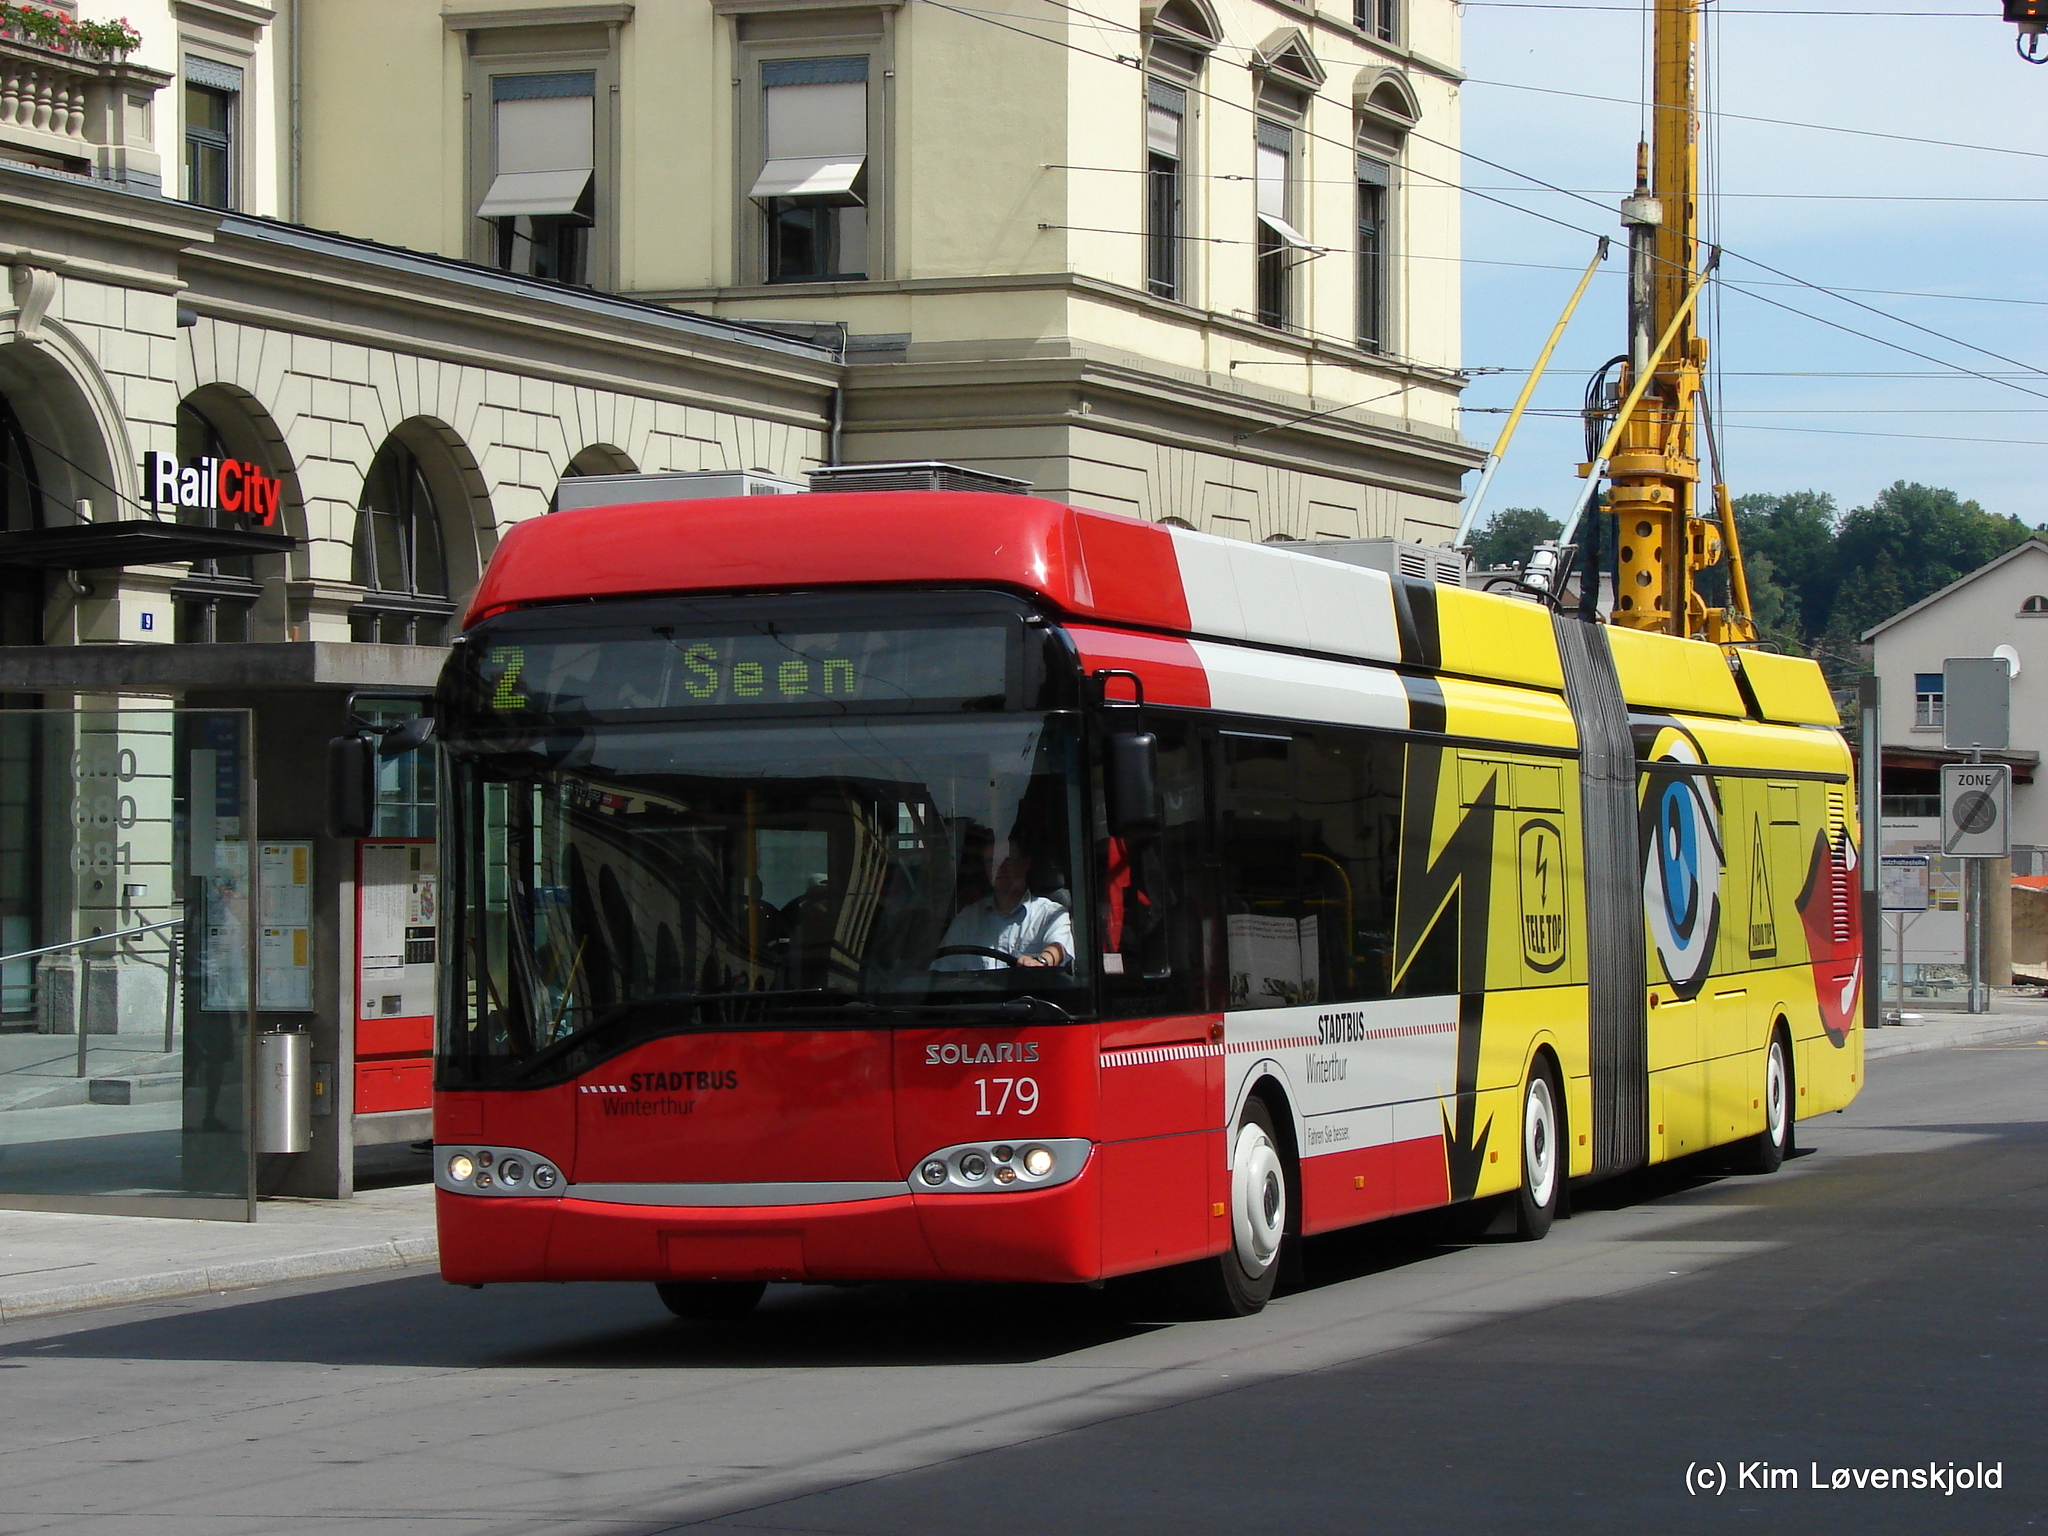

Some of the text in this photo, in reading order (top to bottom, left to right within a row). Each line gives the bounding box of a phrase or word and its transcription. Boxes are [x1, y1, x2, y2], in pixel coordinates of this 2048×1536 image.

[156, 450, 282, 527] RailCity
[145, 614, 151, 629] 9
[492, 643, 855, 709] 2 Seen
[1958, 774, 1992, 786] ZONE
[70, 794, 137, 829] 680
[70, 841, 131, 876] 681
[1525, 914, 1562, 954] TELE TOP
[1318, 1011, 1365, 1045] STADTBUS
[925, 1041, 1040, 1065] SOLARIS
[1305, 1051, 1347, 1084] Winterthur
[630, 1070, 738, 1092] STADTBUS
[974, 1076, 1040, 1115] 179
[603, 1096, 696, 1116] Winterthur
[1308, 1127, 1324, 1145] Fahren
